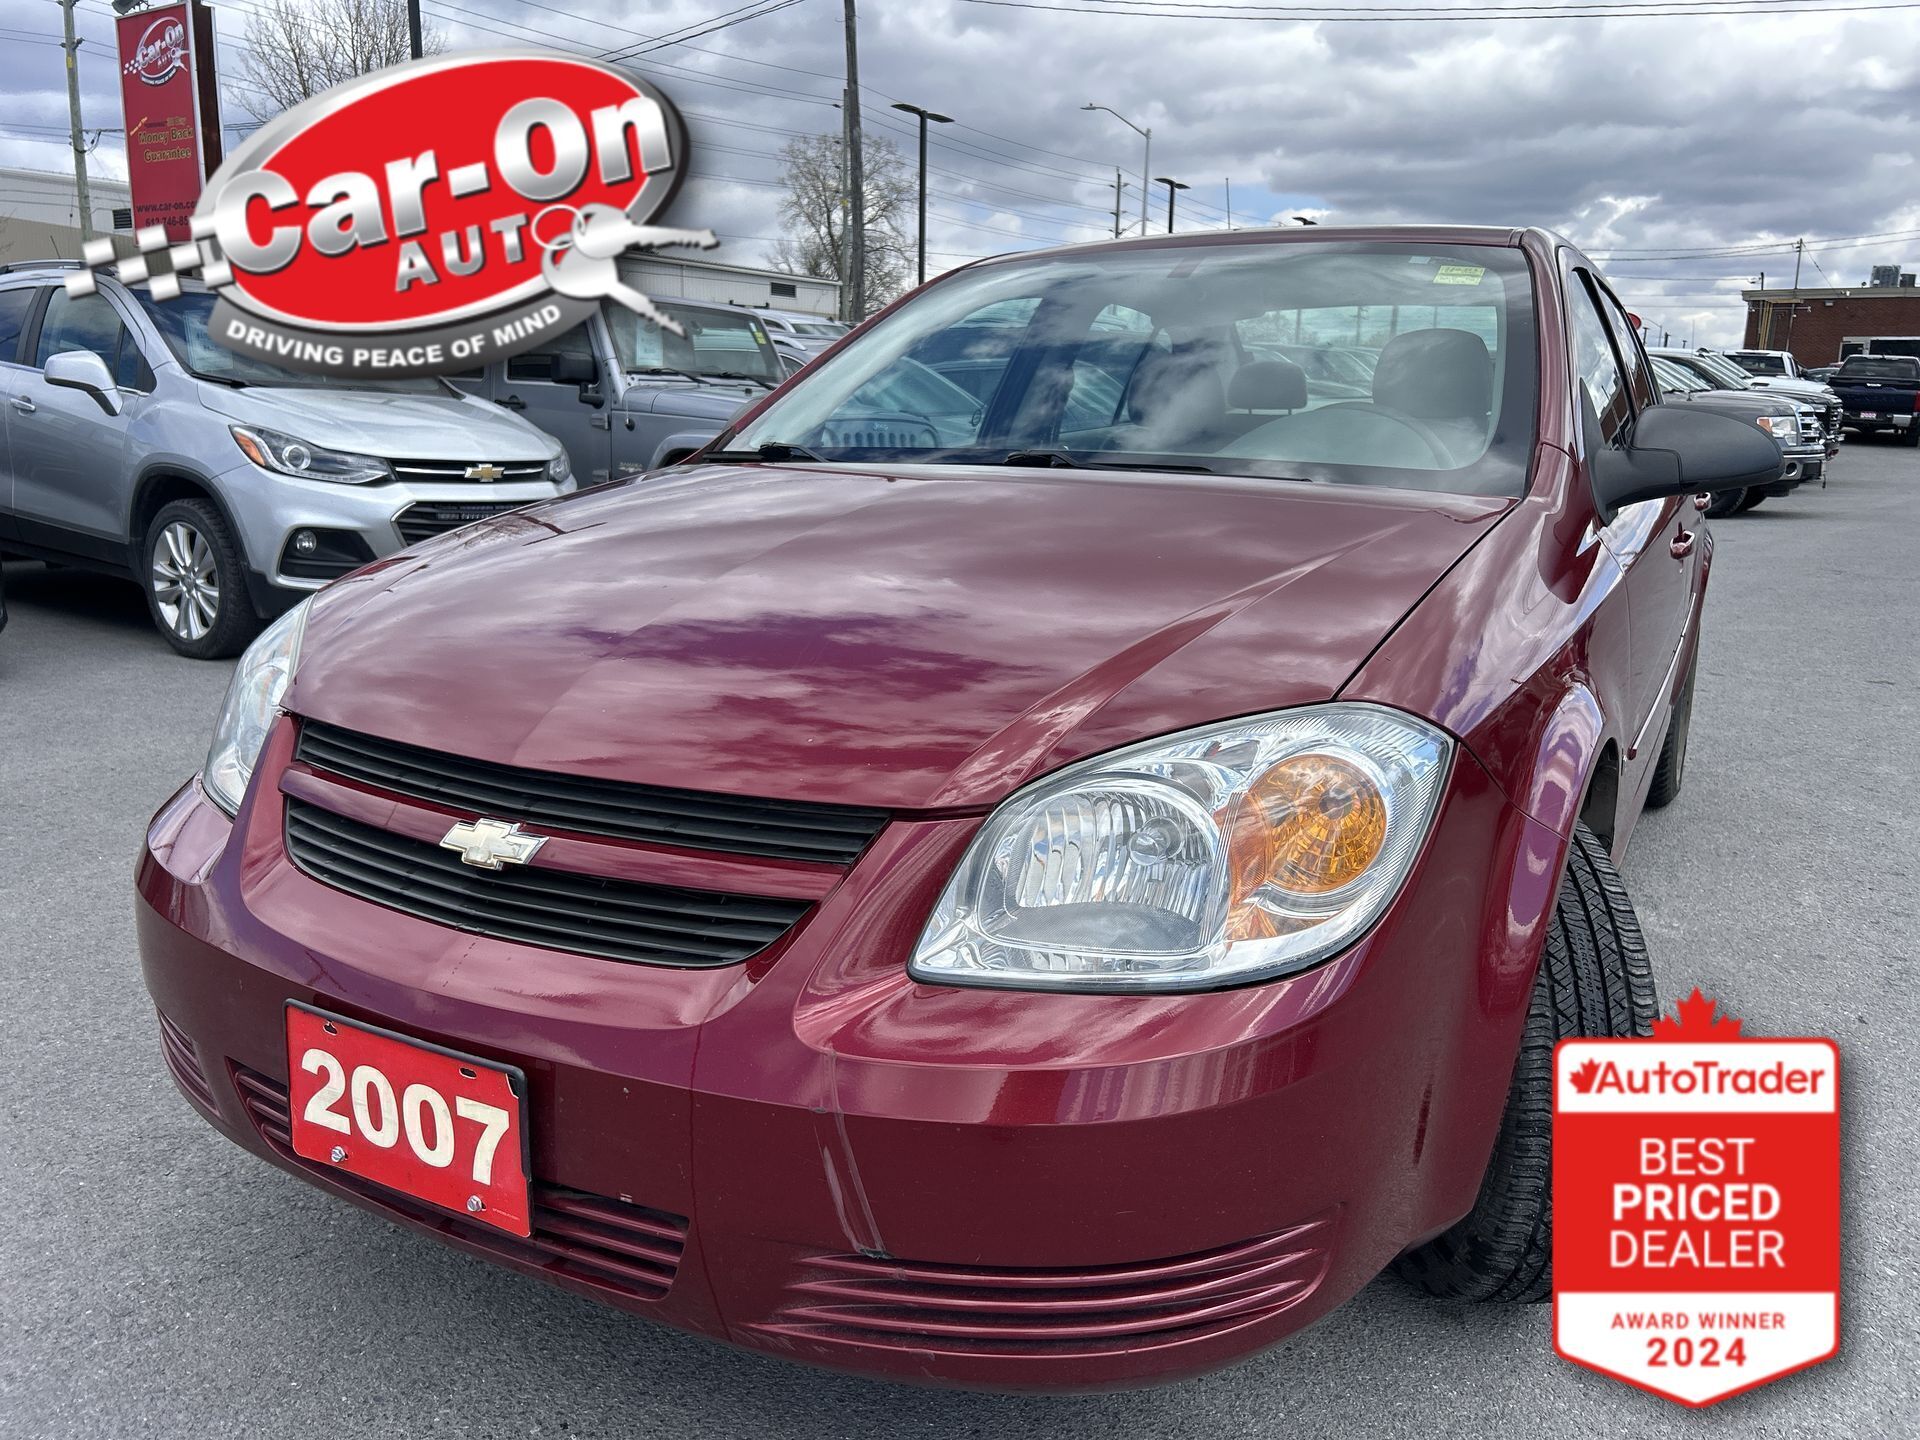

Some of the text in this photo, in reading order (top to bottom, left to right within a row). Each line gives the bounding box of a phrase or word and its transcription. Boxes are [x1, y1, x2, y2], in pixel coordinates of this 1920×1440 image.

[138, 23, 185, 68] Car-On
[138, 127, 194, 145] Money Back
[144, 146, 192, 162] Guarantee
[301, 1048, 509, 1186] 2007
